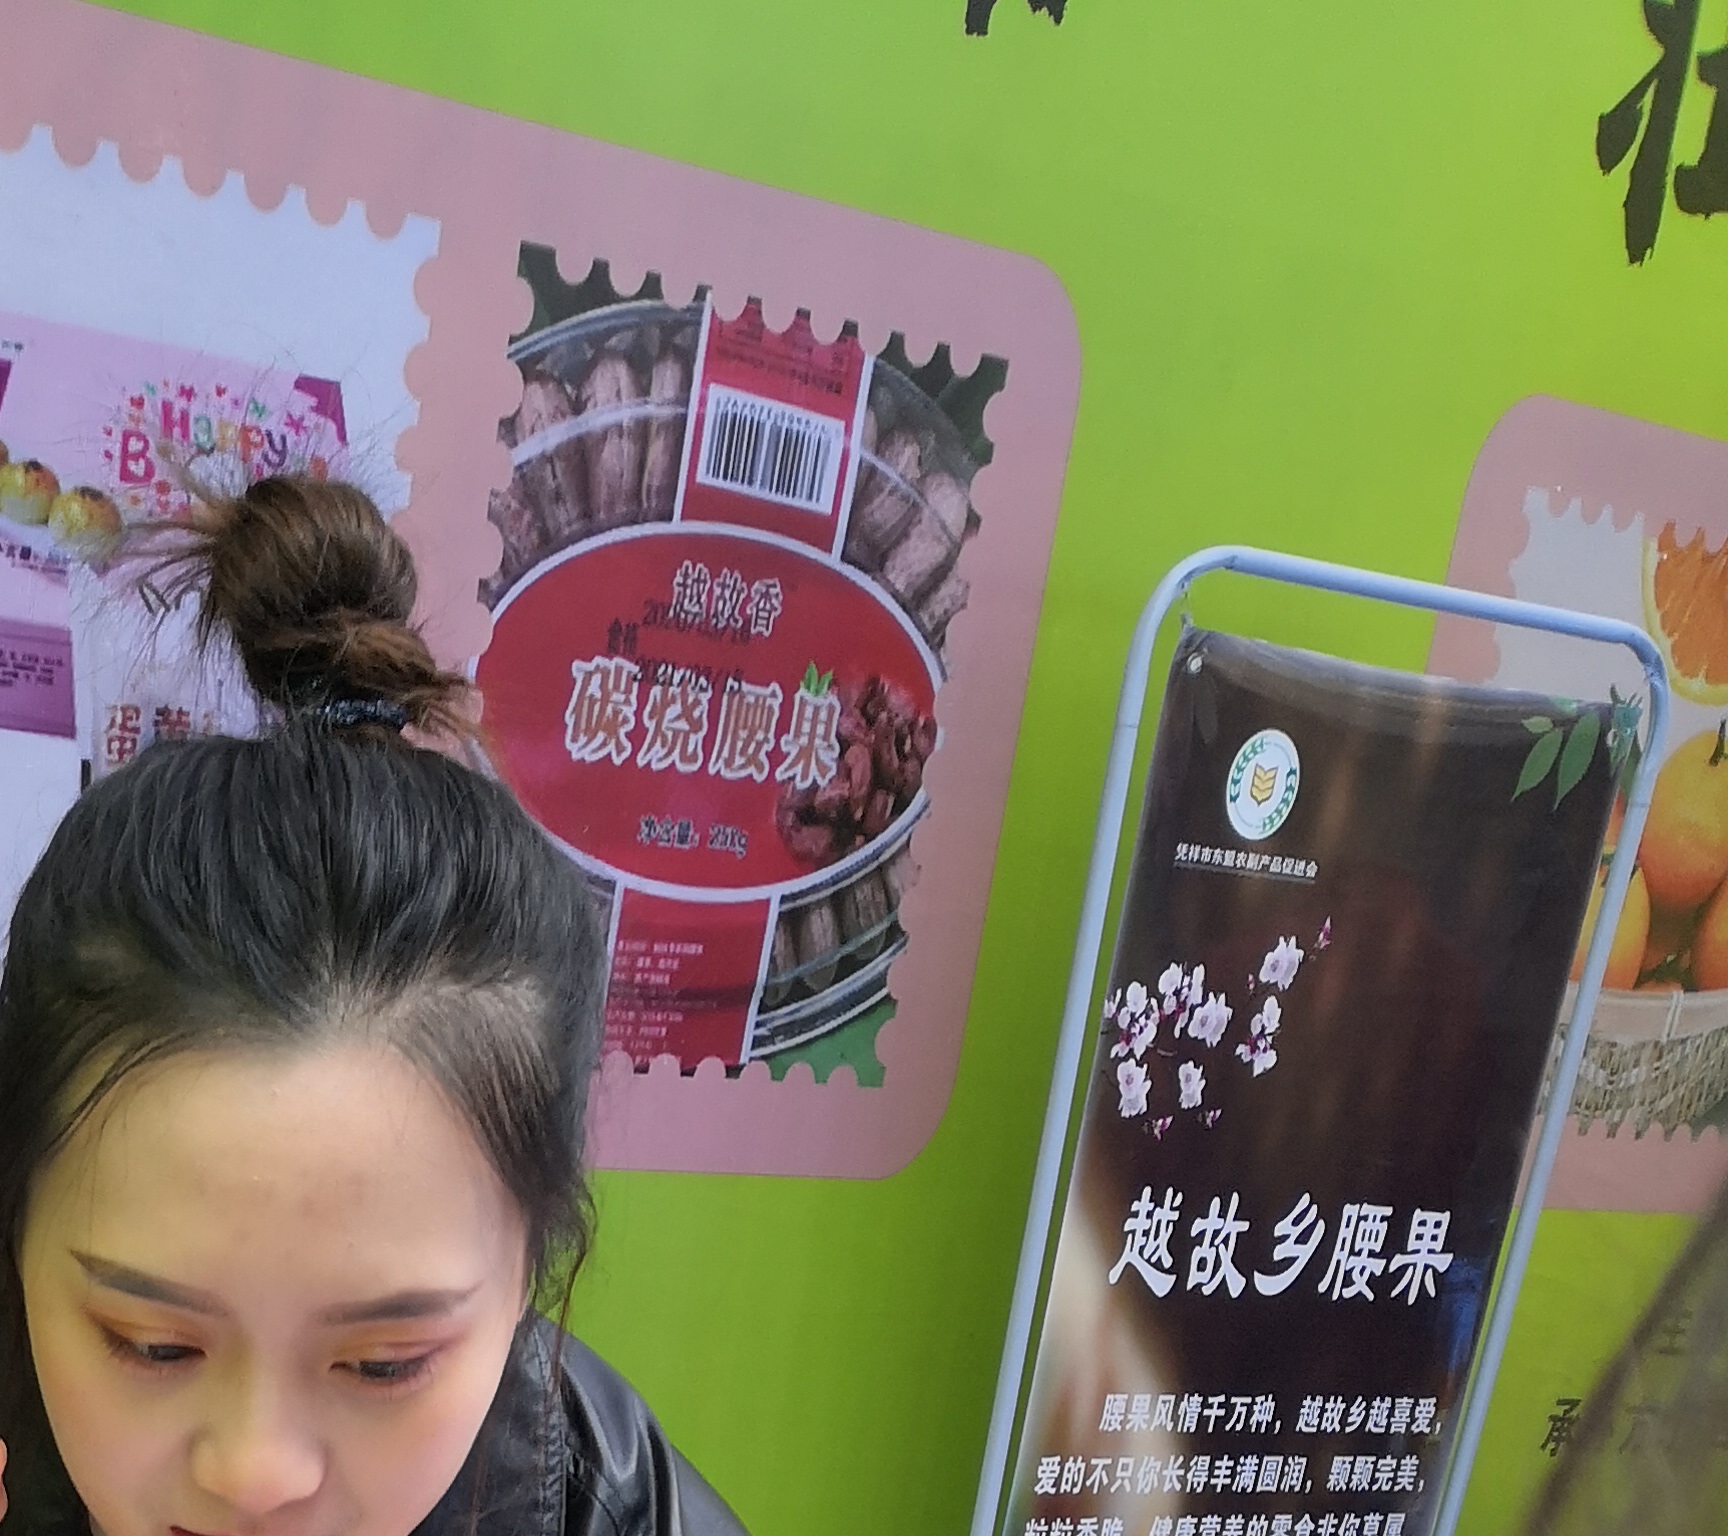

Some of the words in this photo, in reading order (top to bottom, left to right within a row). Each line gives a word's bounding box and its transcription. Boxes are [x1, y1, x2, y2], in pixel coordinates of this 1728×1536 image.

[564, 655, 842, 790] 碳烧腰果
[1174, 841, 1319, 880] 凭祥市东盟农副产品促进会
[1108, 1185, 1456, 1307] 越故乡腰果
